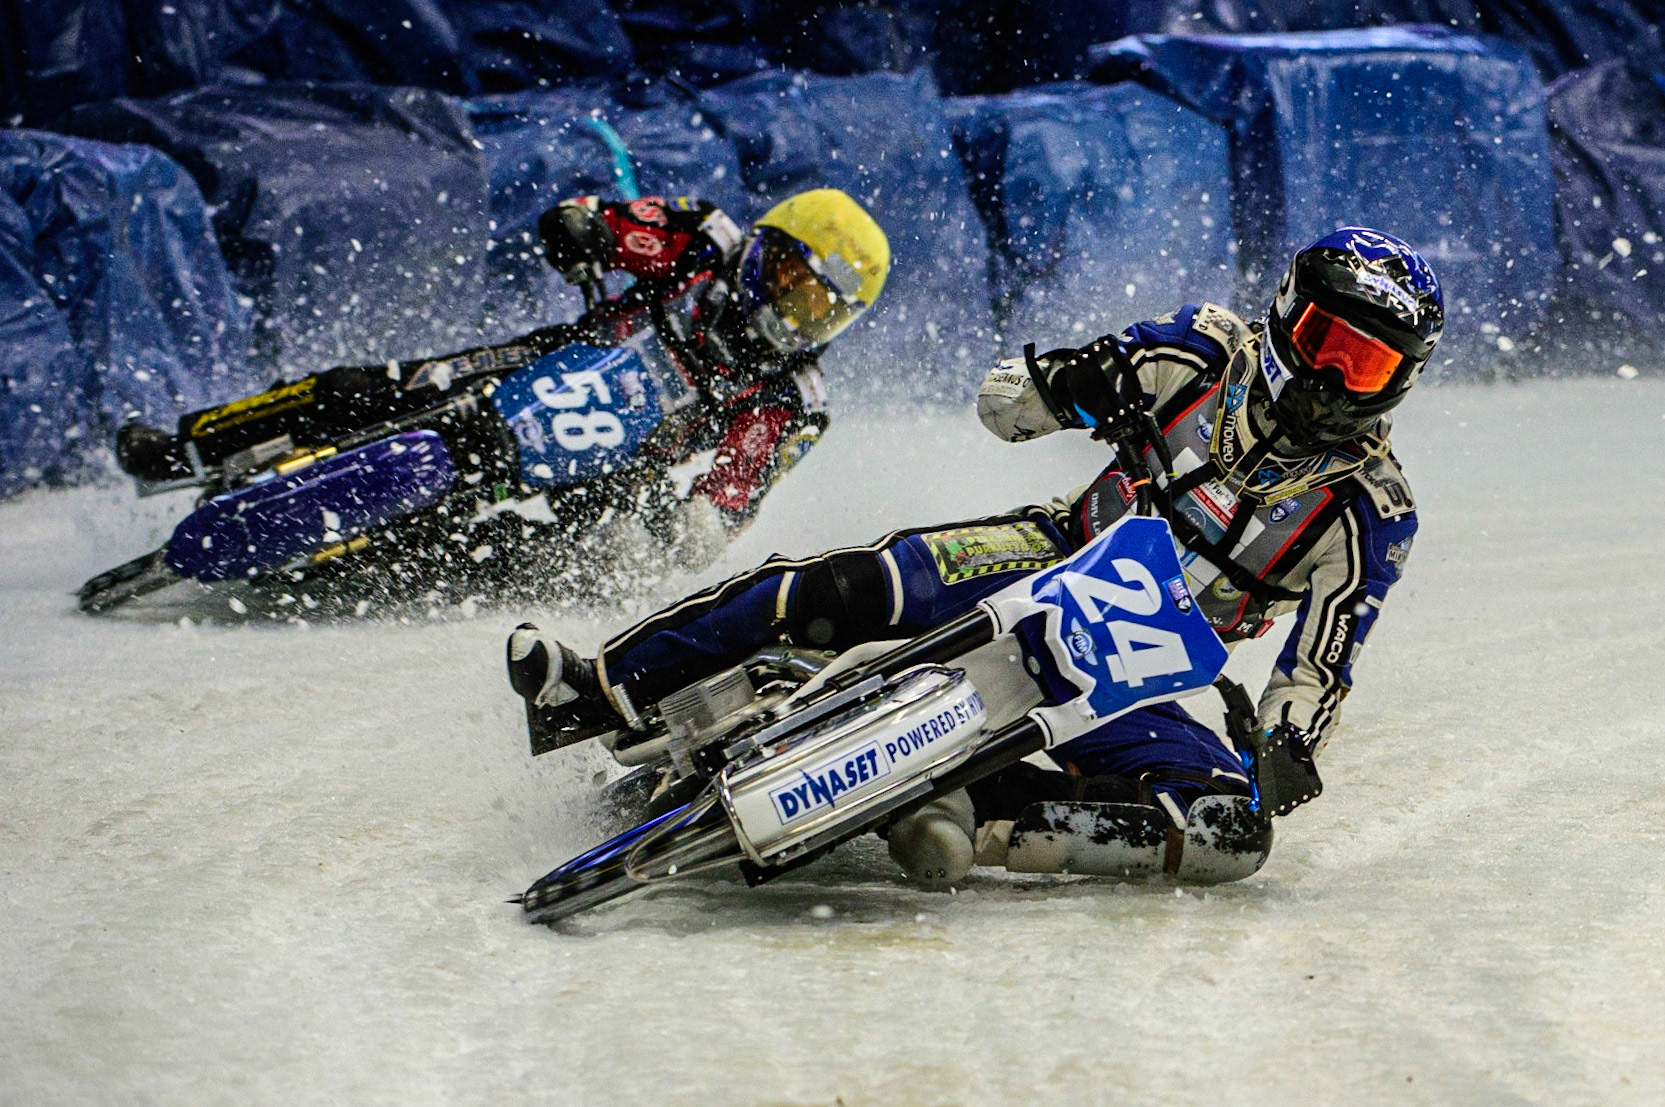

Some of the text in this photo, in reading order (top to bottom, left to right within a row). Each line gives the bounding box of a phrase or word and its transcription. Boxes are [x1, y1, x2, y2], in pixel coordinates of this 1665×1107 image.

[531, 369, 625, 451] 58
[1222, 414, 1237, 463] moveo
[1061, 558, 1192, 688] 24
[1075, 632, 1088, 653] FIM
[1326, 614, 1351, 663] WACO
[885, 710, 955, 763] POWERED
[778, 748, 877, 818] DYNASET
